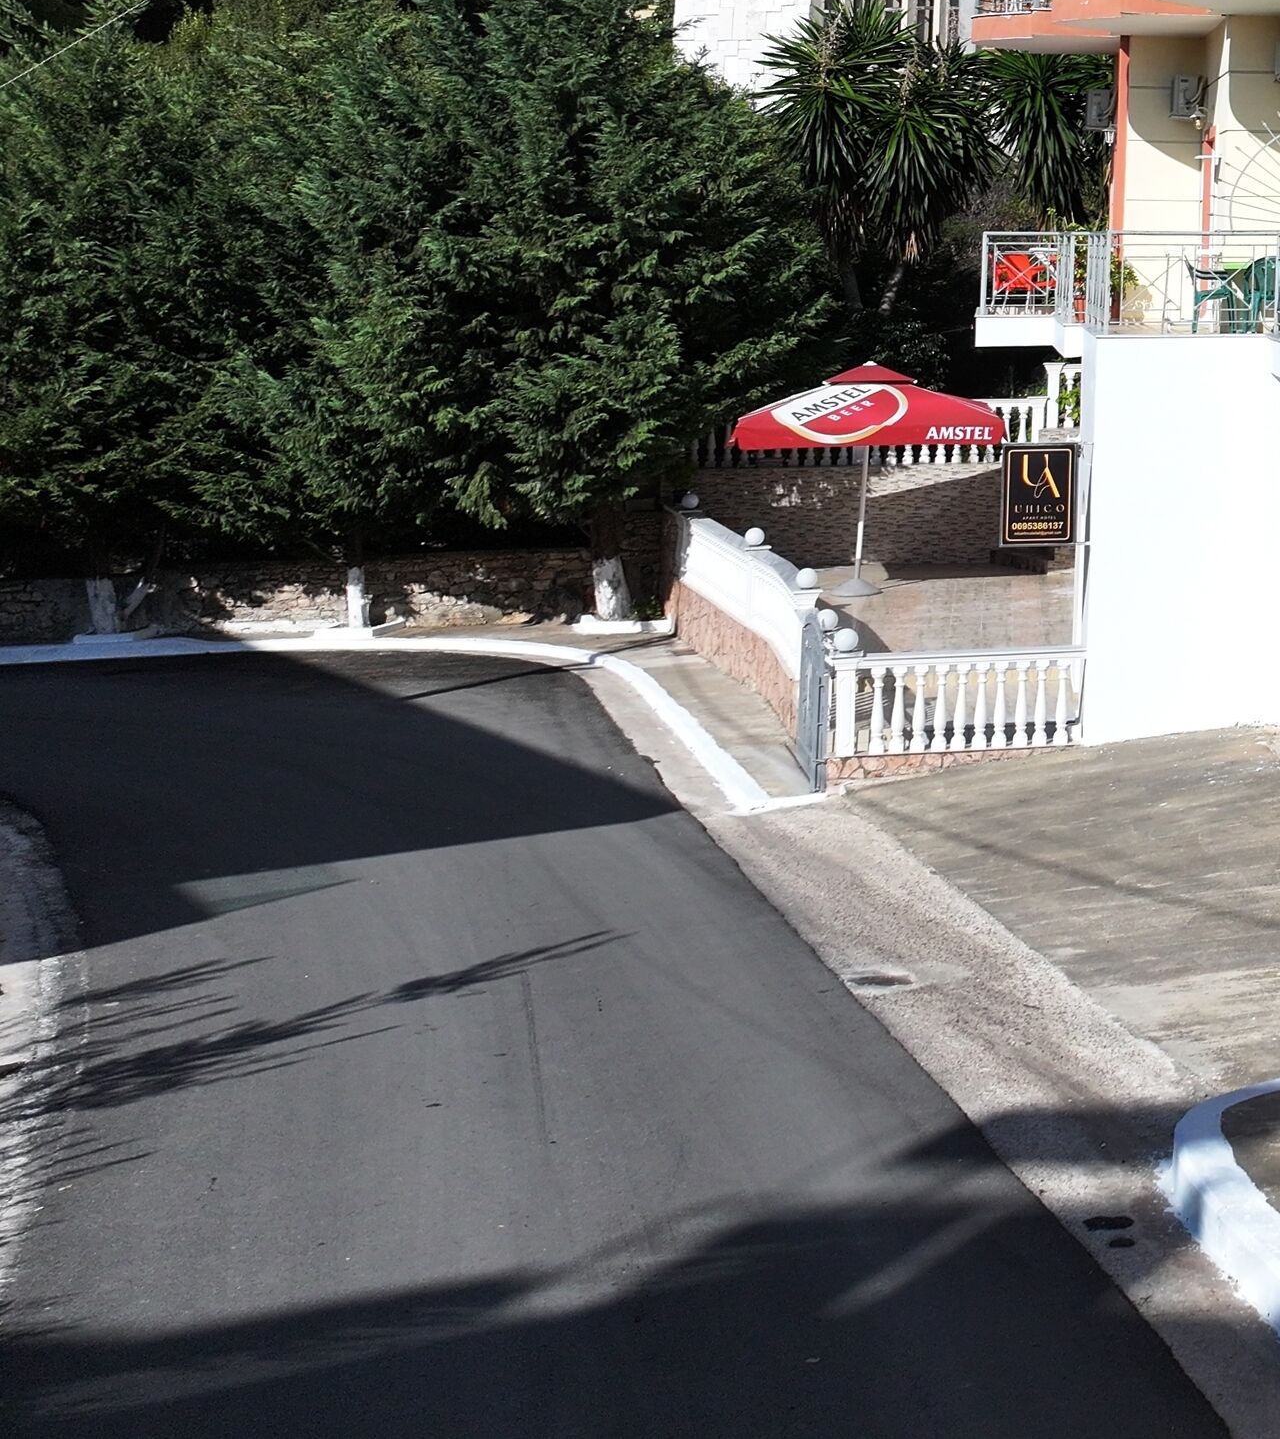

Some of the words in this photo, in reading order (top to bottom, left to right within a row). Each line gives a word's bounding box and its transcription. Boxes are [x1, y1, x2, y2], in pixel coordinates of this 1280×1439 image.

[791, 384, 872, 421] AMSTEL
[828, 400, 875, 422] BEER
[925, 426, 993, 440] AMSTEL
[1011, 522, 1064, 530] 0695386137
